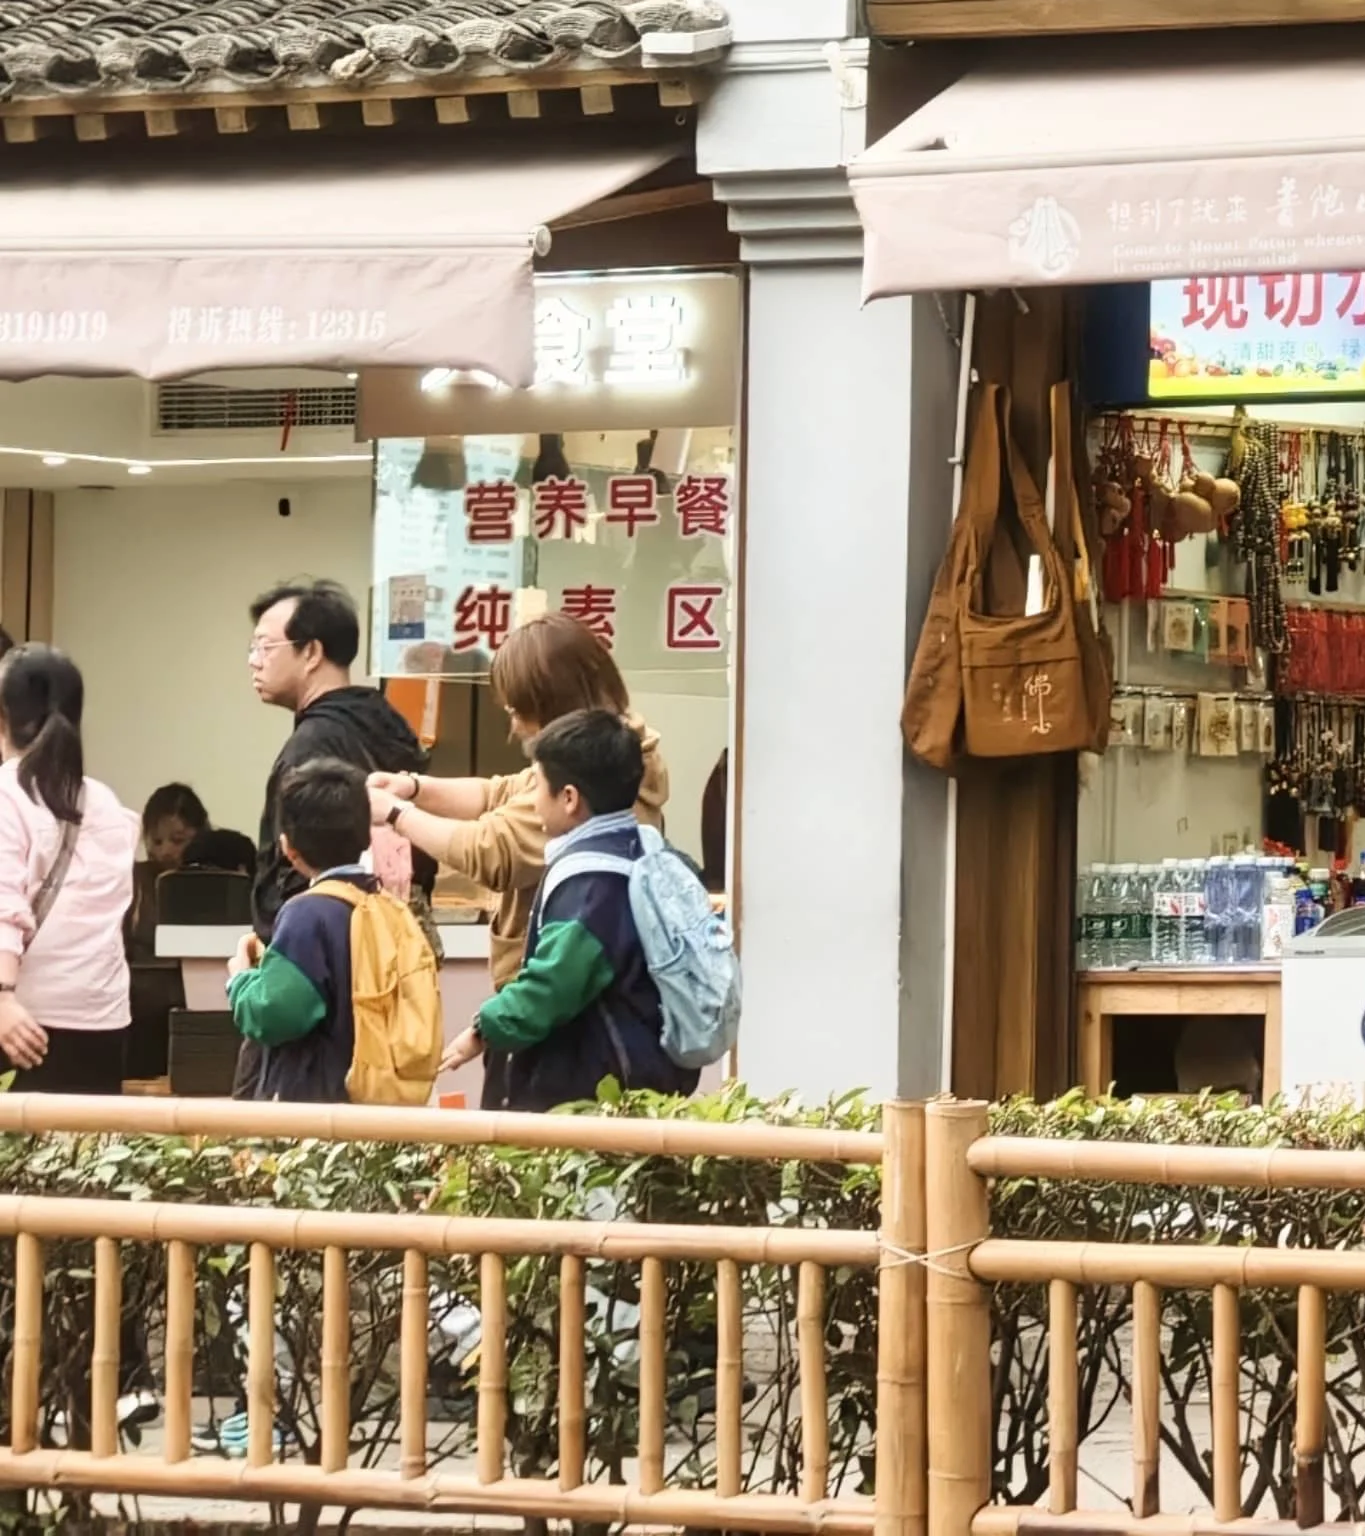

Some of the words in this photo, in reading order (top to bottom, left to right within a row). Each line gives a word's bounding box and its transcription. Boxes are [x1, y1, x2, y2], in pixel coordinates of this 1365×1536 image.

[1107, 196, 1249, 232] 想到了就来
[1113, 243, 1160, 259] Come
[1164, 240, 1182, 254] to
[1189, 238, 1239, 254] Mount
[464, 474, 730, 543] 营养早餐
[453, 584, 724, 651] 纯素区
